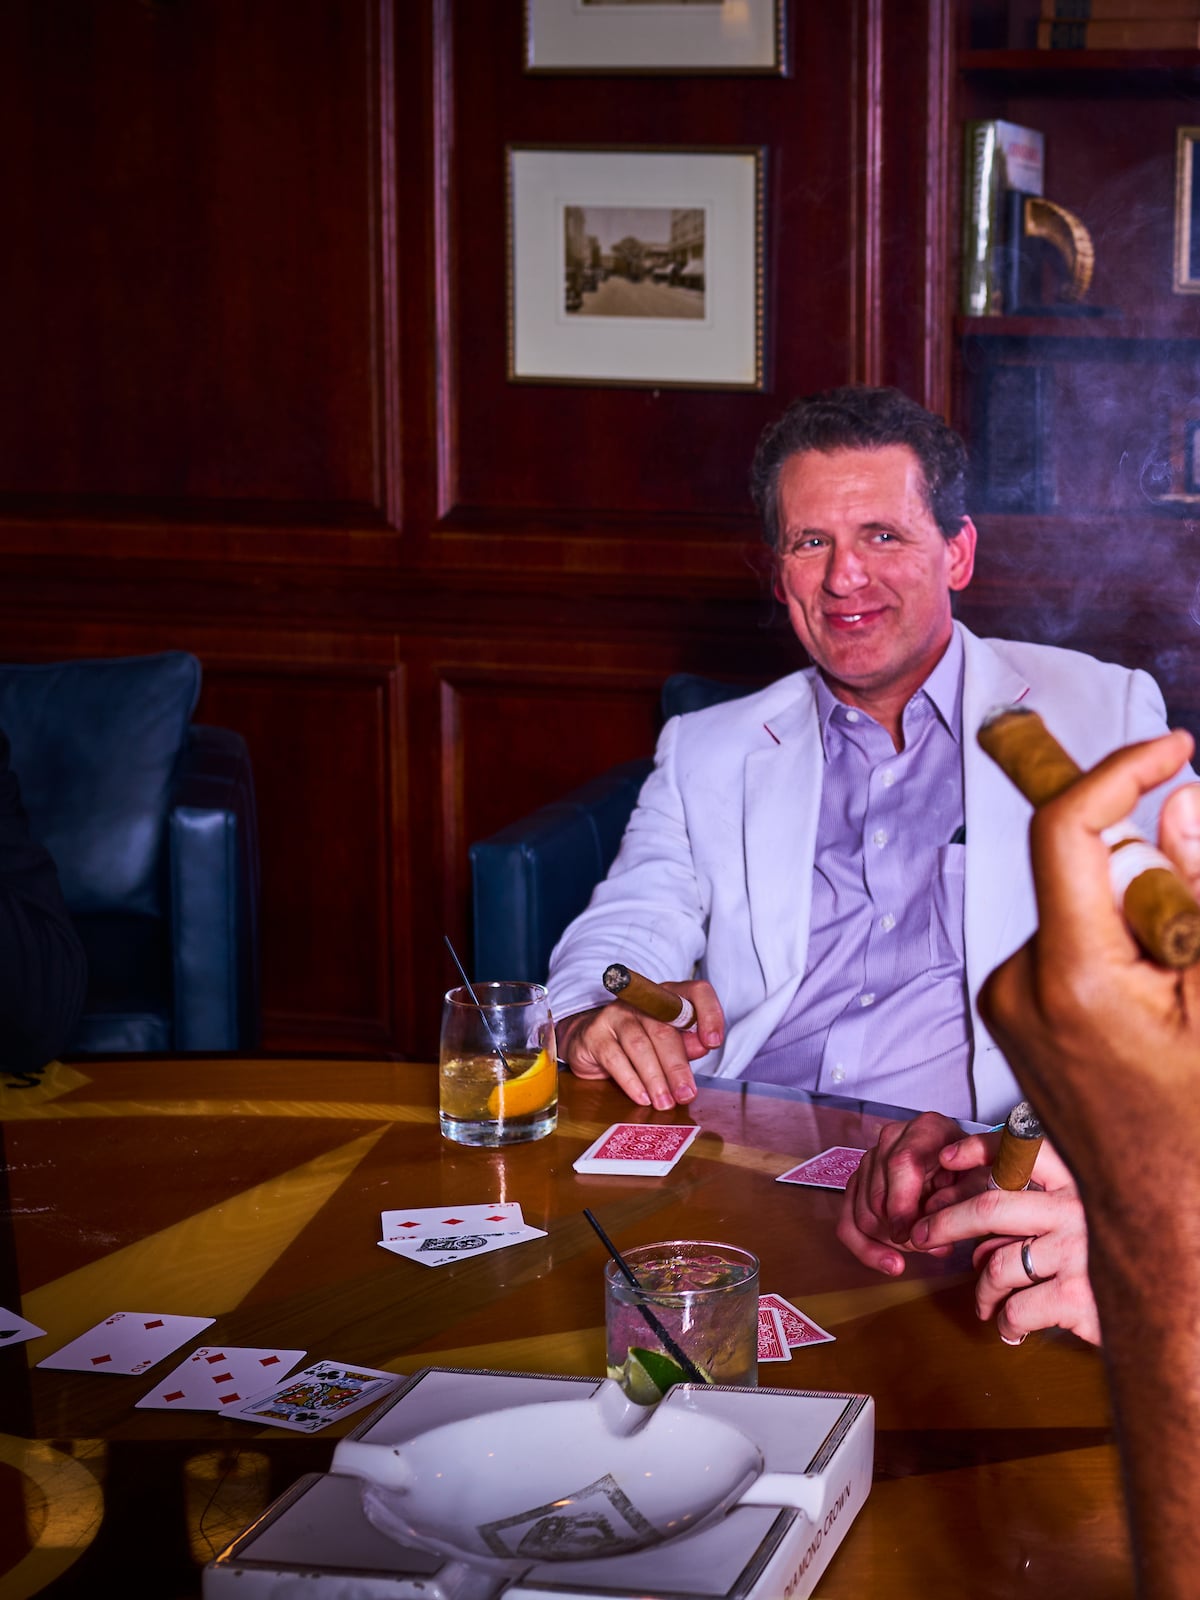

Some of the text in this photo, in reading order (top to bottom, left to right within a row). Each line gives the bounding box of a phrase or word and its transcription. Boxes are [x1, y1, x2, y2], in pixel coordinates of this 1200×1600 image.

[197, 1349, 209, 1357] 5
[315, 1363, 329, 1371] K
[306, 1421, 323, 1431] K
[783, 1480, 852, 1600] DIAMOND CROWN
